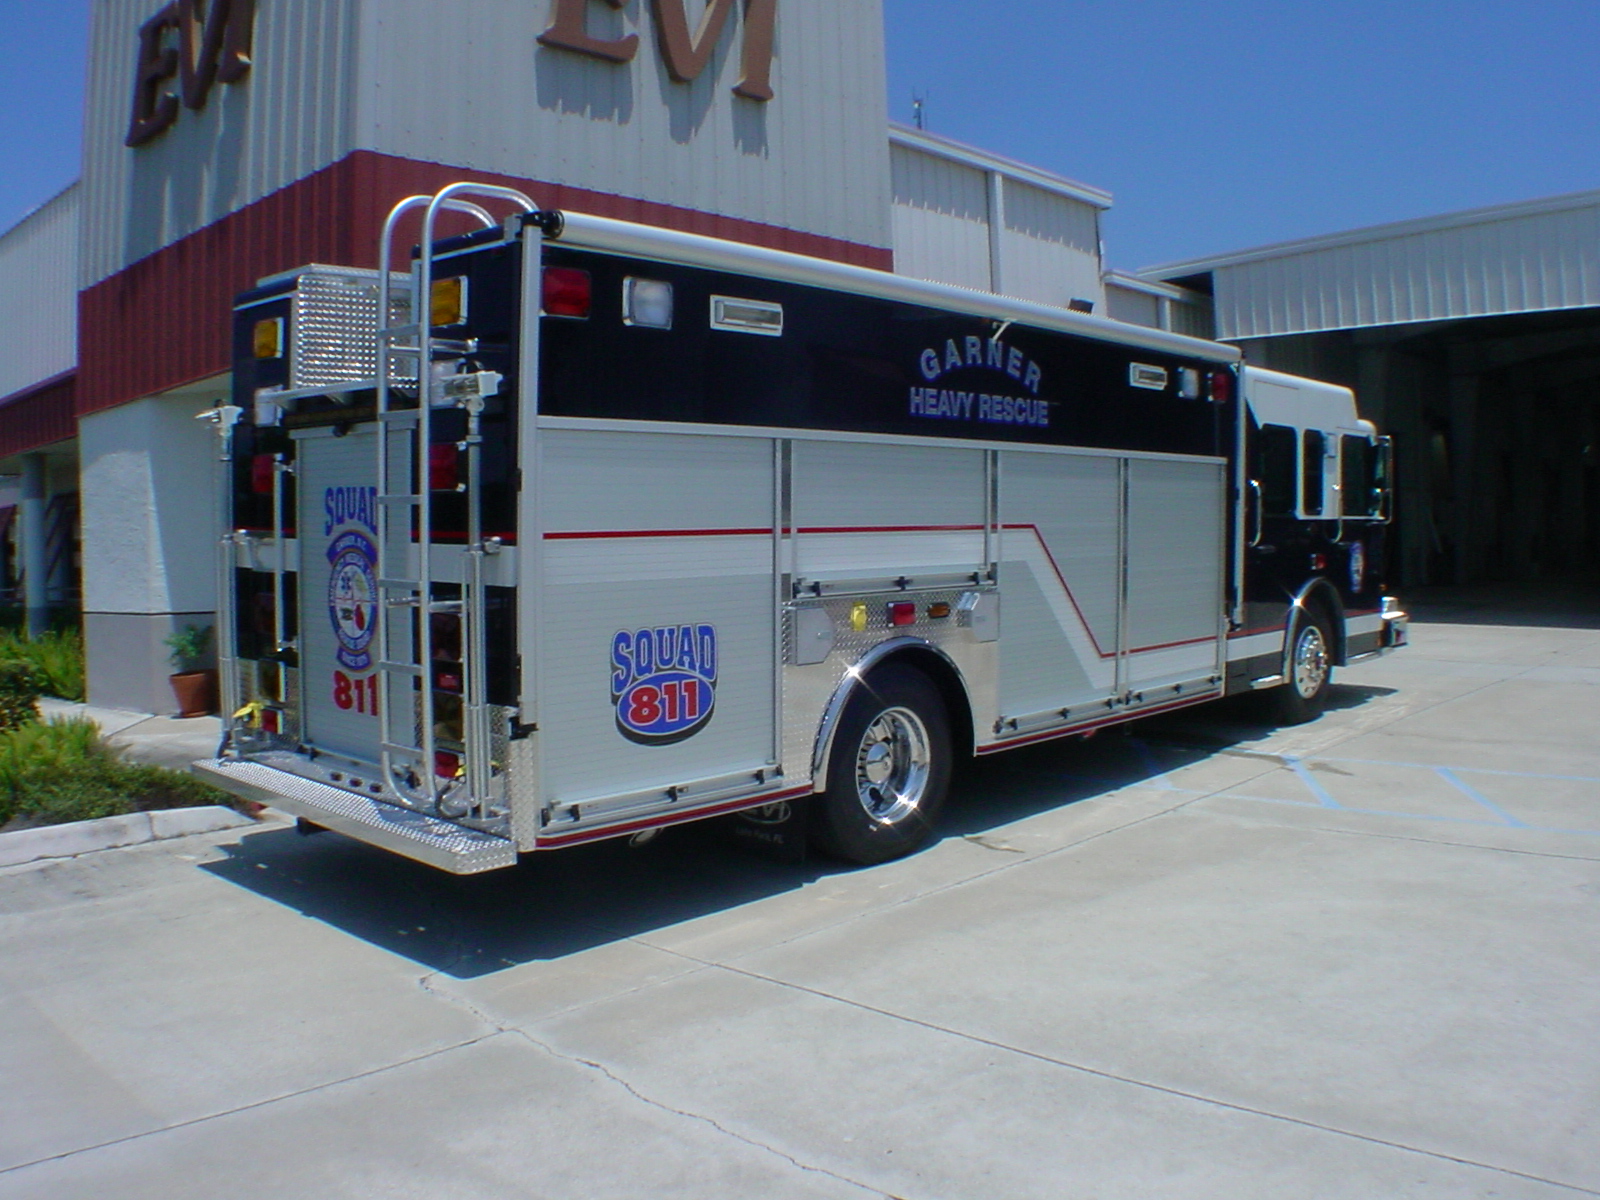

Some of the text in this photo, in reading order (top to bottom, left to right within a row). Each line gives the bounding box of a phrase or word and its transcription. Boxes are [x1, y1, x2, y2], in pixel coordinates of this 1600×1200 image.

[125, 0, 255, 148] EVI
[920, 335, 1043, 394] GARNER
[909, 386, 1049, 426] HEAVY RESCUE
[612, 623, 717, 695] SQUAD
[333, 669, 378, 716] 811
[628, 679, 699, 726] 811
